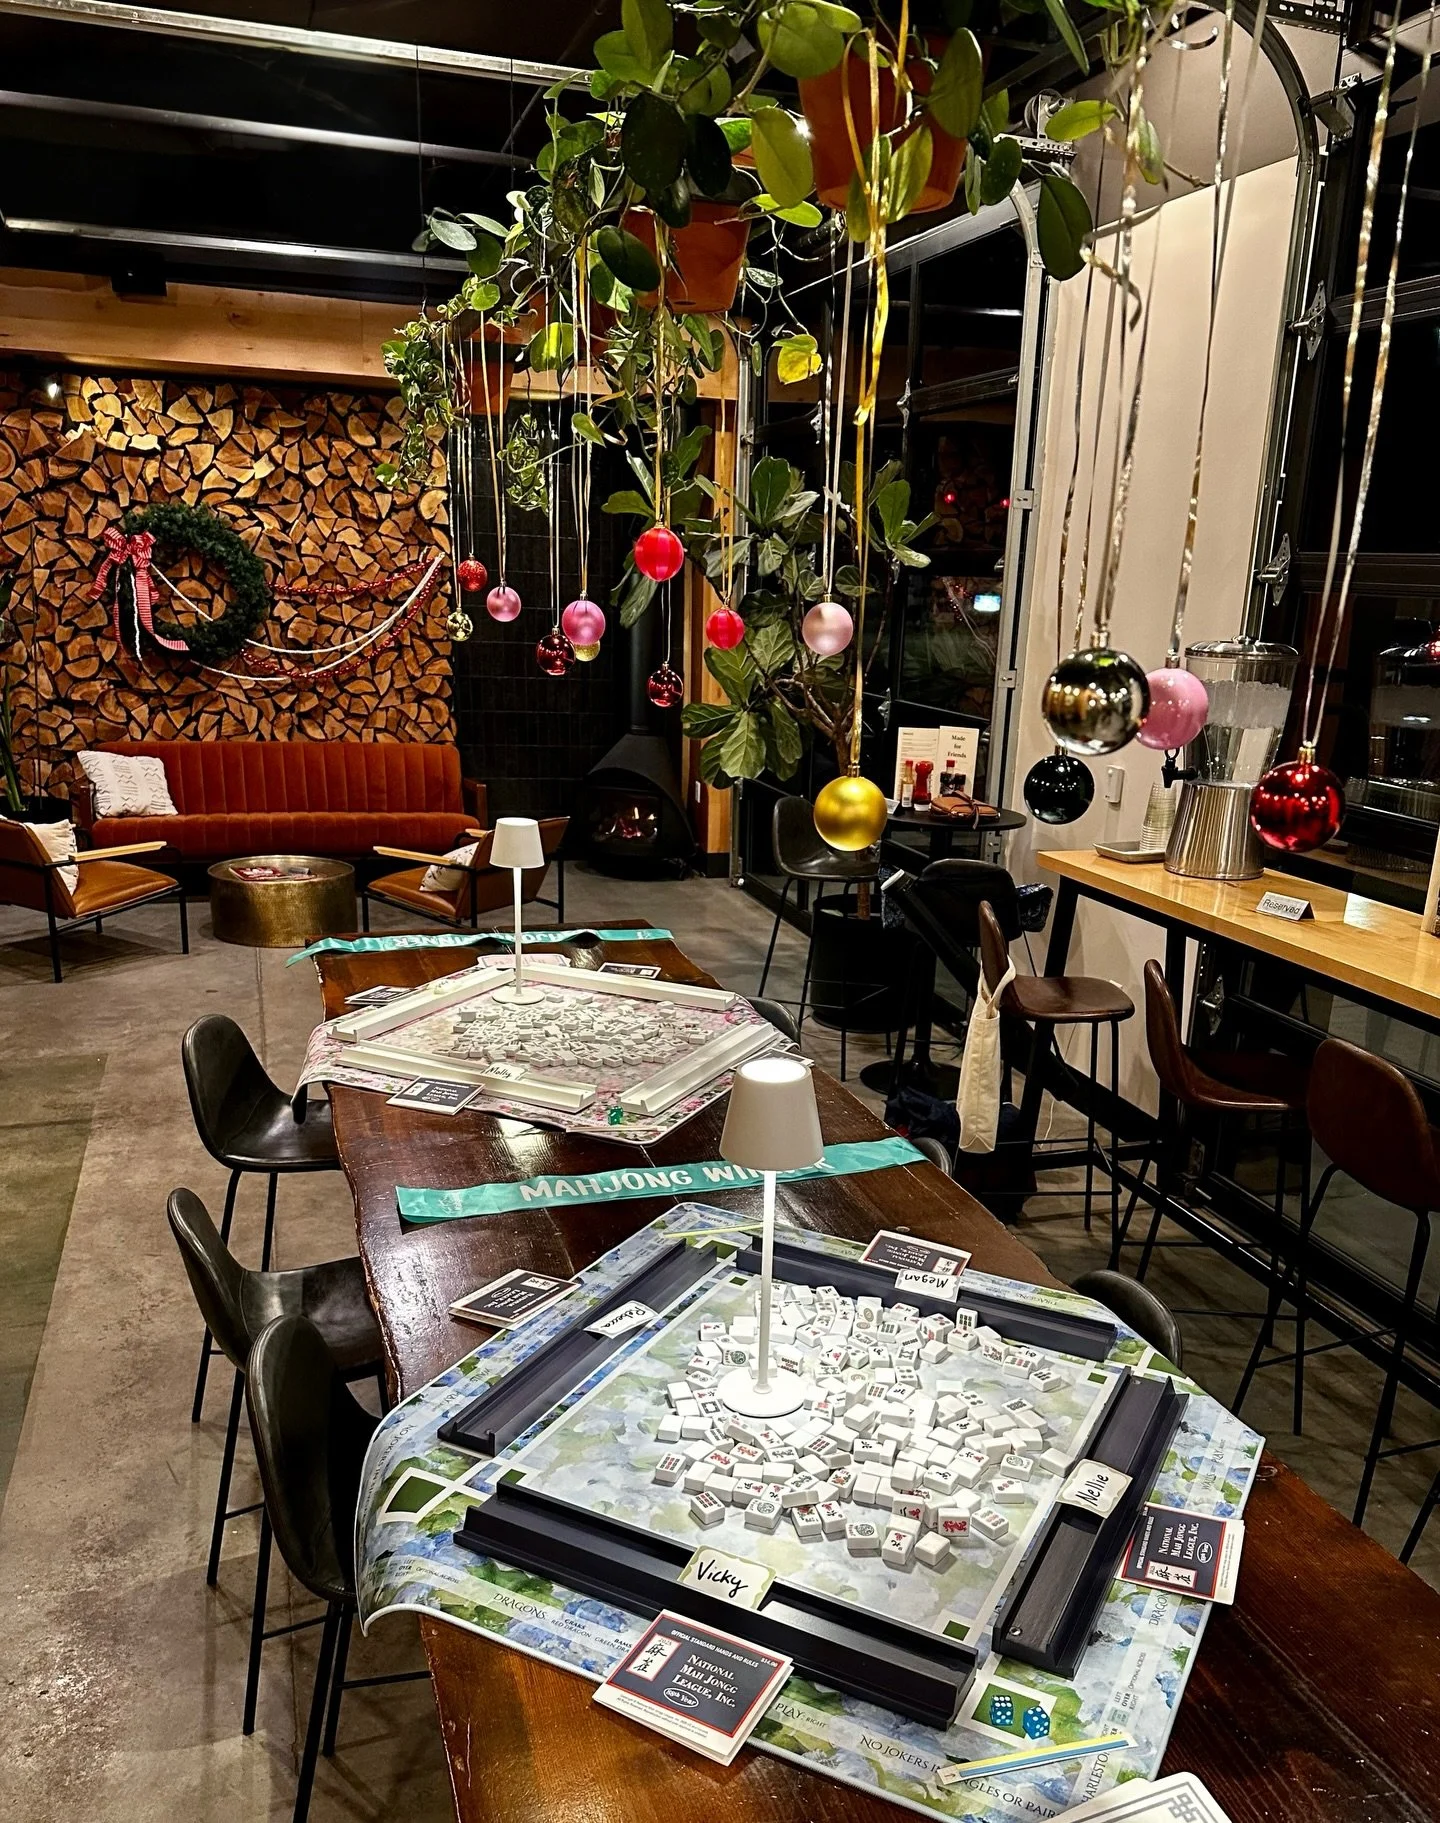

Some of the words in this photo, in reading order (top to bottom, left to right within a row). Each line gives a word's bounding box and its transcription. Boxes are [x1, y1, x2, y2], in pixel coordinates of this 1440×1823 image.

[951, 734, 966, 742] Made
[947, 751, 967, 759] Friends
[1262, 898, 1301, 915] Reserved
[519, 1168, 693, 1203] MAHJONG
[904, 1273, 949, 1289] Megan
[1075, 1474, 1110, 1507] Nellie
[1158, 1526, 1174, 1555] NATIONAL
[1170, 1543, 1181, 1558] MAH
[697, 1559, 749, 1598] Vicky
[1148, 1591, 1170, 1626] DRAGON
[551, 1619, 564, 1630] RED
[564, 1623, 592, 1639] DRAGON
[564, 1618, 587, 1630] CRAKS
[594, 1636, 617, 1650] GREEN
[614, 1638, 633, 1649] BAMS
[670, 1629, 690, 1642] OFFICIAL
[690, 1635, 716, 1651] STANDARD
[715, 1645, 732, 1658] HANDS
[731, 1651, 743, 1662] AND
[742, 1655, 759, 1668] RULES
[687, 1654, 735, 1681] NATIONAL
[680, 1664, 704, 1684] MAH
[703, 1675, 739, 1695] JONGG
[672, 1674, 714, 1701] LEAGUE,
[714, 1691, 736, 1708] INC.
[680, 1694, 698, 1707] Year
[1121, 1693, 1132, 1708] OVER
[805, 1716, 828, 1729] RIGHT
[860, 1734, 884, 1752] NO
[884, 1743, 929, 1771] JOKERS
[1002, 1792, 1023, 1808] OR
[1025, 1801, 1061, 1818] PAIR
[1081, 1751, 1111, 1803] HARLESTO
